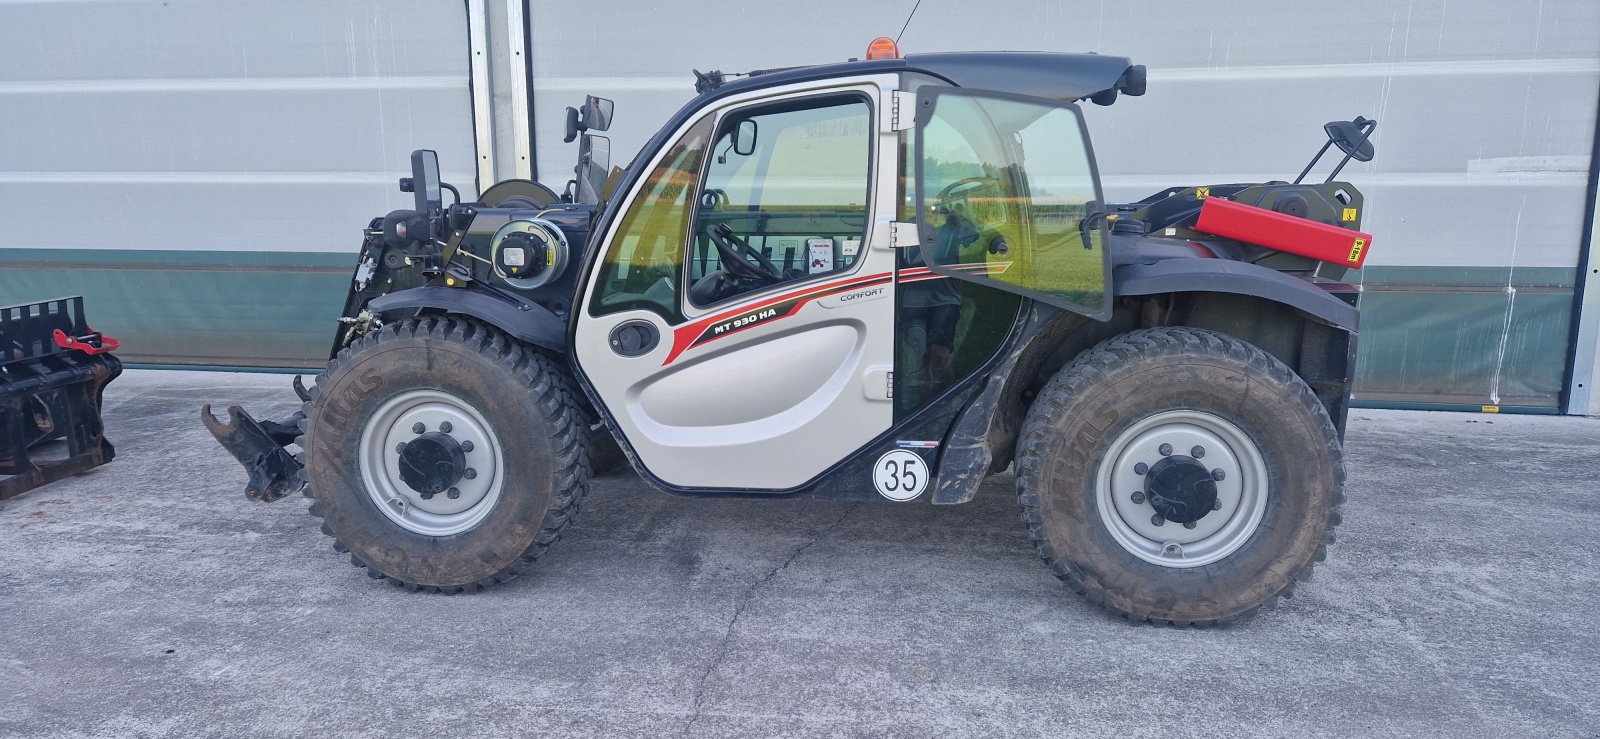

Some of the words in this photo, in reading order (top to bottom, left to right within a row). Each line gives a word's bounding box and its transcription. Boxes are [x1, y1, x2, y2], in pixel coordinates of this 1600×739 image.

[840, 287, 884, 302] COMFORT
[714, 322, 732, 335] MT
[734, 314, 757, 328] 930
[758, 308, 776, 319] HA
[884, 460, 916, 492] 35
